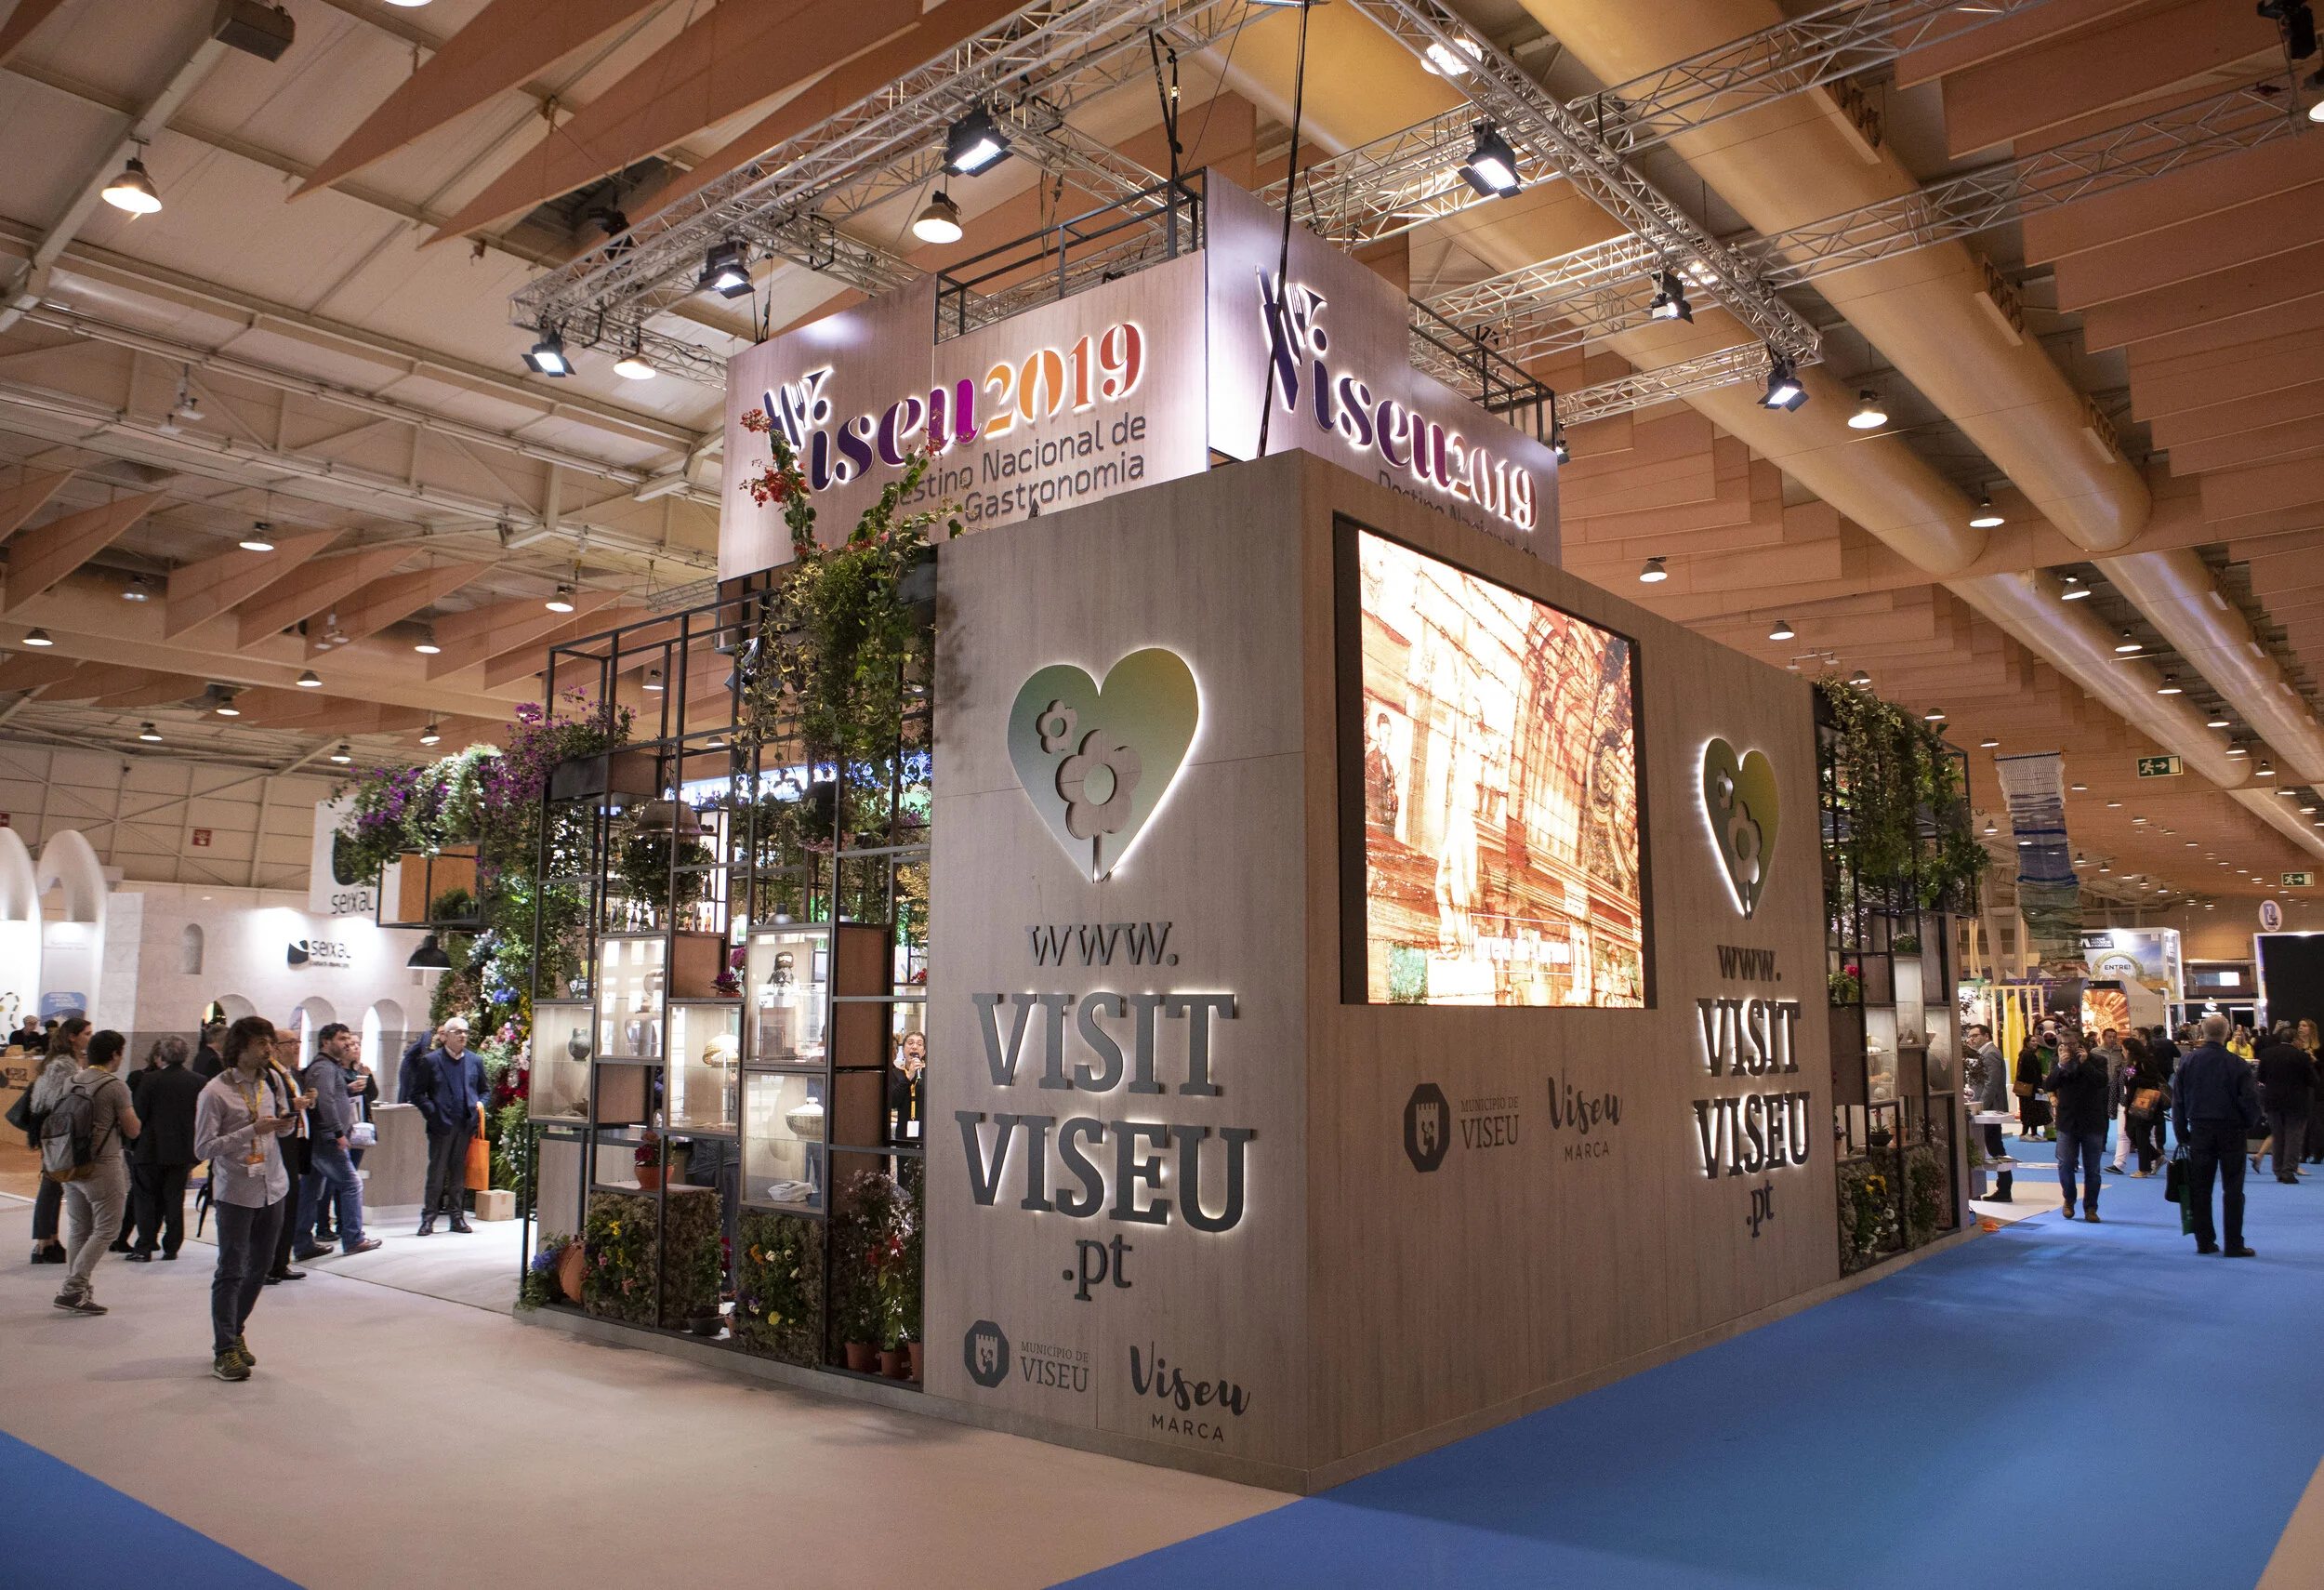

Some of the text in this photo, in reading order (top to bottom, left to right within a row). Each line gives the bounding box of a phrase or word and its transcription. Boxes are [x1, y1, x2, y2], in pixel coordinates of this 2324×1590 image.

[983, 419, 1102, 484] Nacional
[1112, 412, 1146, 446] de
[965, 453, 1145, 523] Gastronomia
[1025, 921, 1179, 966] www.
[1717, 945, 1782, 982] www.
[971, 991, 1235, 1096] VISIT
[1697, 998, 1802, 1077] VISIT
[1459, 1115, 1520, 1150] VISEU
[1508, 1096, 1519, 1109] DE
[1547, 1067, 1623, 1135] Viseu
[1564, 1141, 1610, 1161] MARCA
[1693, 1091, 1811, 1180] VISEU
[955, 1110, 1254, 1233] VISEU
[1746, 1179, 1775, 1239] .pt
[1062, 1234, 1132, 1302] .pt
[1020, 1357, 1089, 1393] VISEU
[1076, 1351, 1089, 1363] DE
[1129, 1341, 1251, 1416] Viseu
[1151, 1413, 1224, 1442] MARCA
